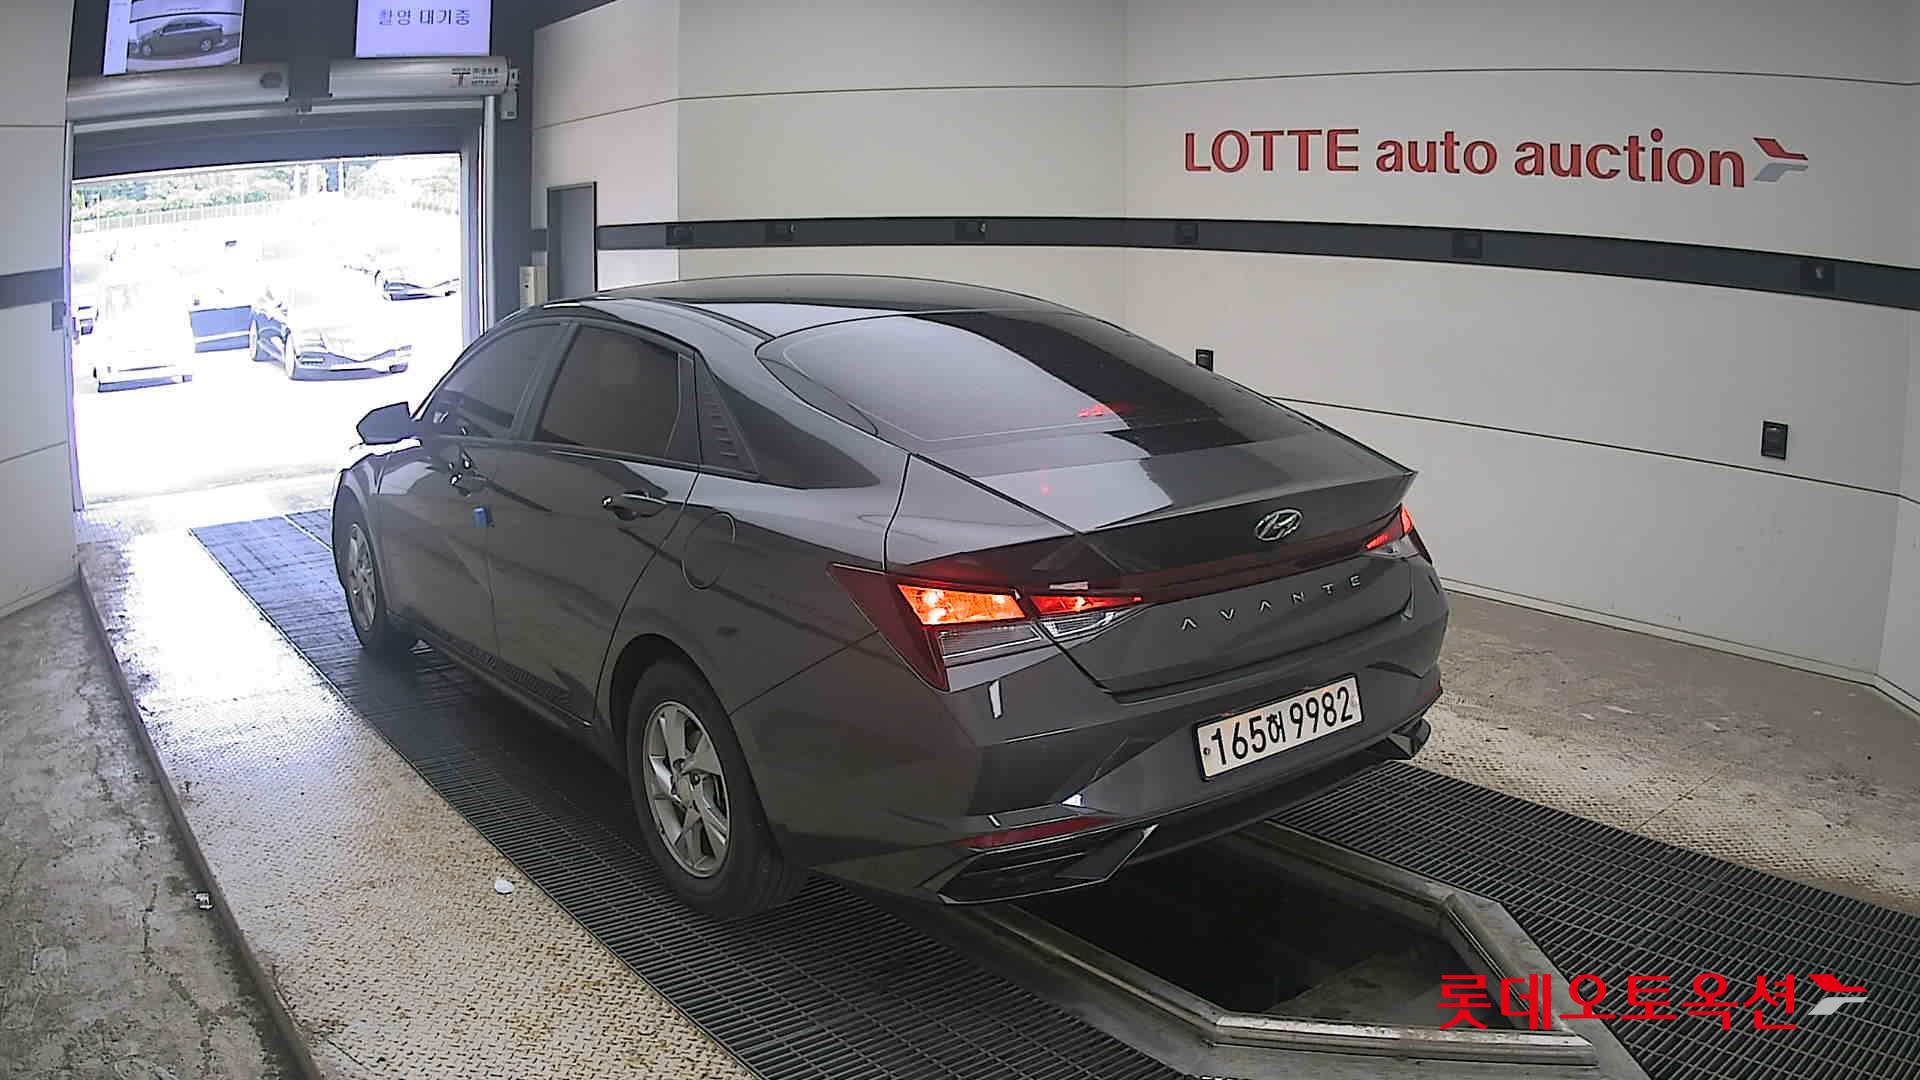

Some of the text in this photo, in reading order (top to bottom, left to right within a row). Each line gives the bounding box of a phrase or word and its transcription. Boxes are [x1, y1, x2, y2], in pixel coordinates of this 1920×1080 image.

[419, 9, 472, 26] 대기중
[1184, 128, 1745, 188] LOTTE auto auction
[1181, 575, 1361, 631] AVANTE
